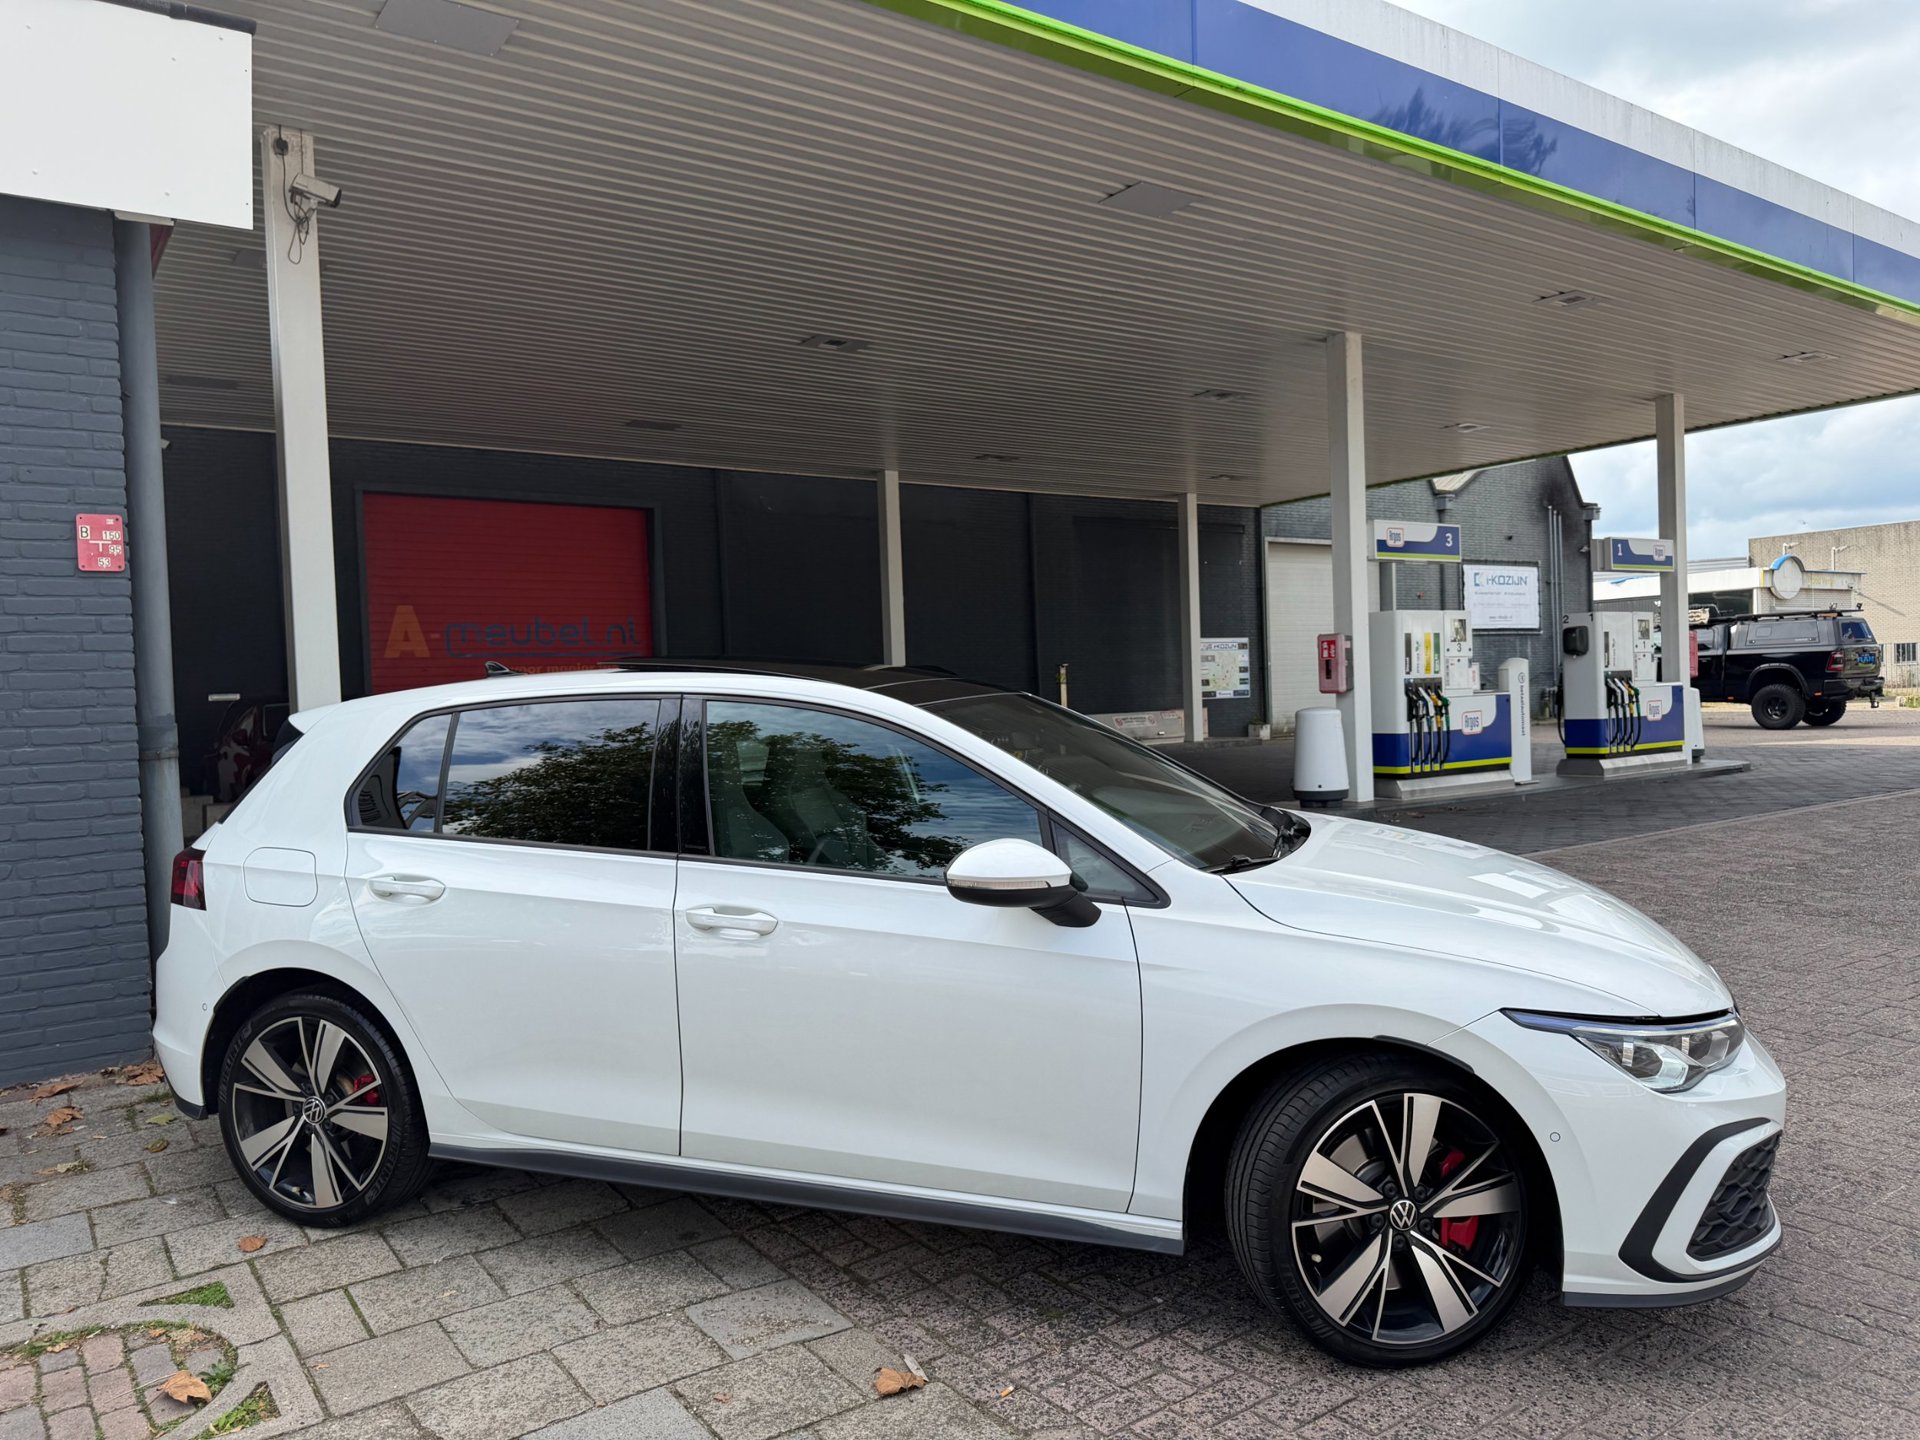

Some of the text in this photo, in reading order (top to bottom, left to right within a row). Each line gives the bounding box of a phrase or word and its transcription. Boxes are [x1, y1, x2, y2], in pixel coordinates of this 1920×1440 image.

[80, 526, 89, 538] B
[104, 532, 120, 540] 150
[1445, 533, 1453, 547] 3
[1617, 543, 1623, 556] 1
[1562, 615, 1569, 624] 2
[1457, 642, 1462, 652] 3
[1464, 715, 1480, 731] Argos
